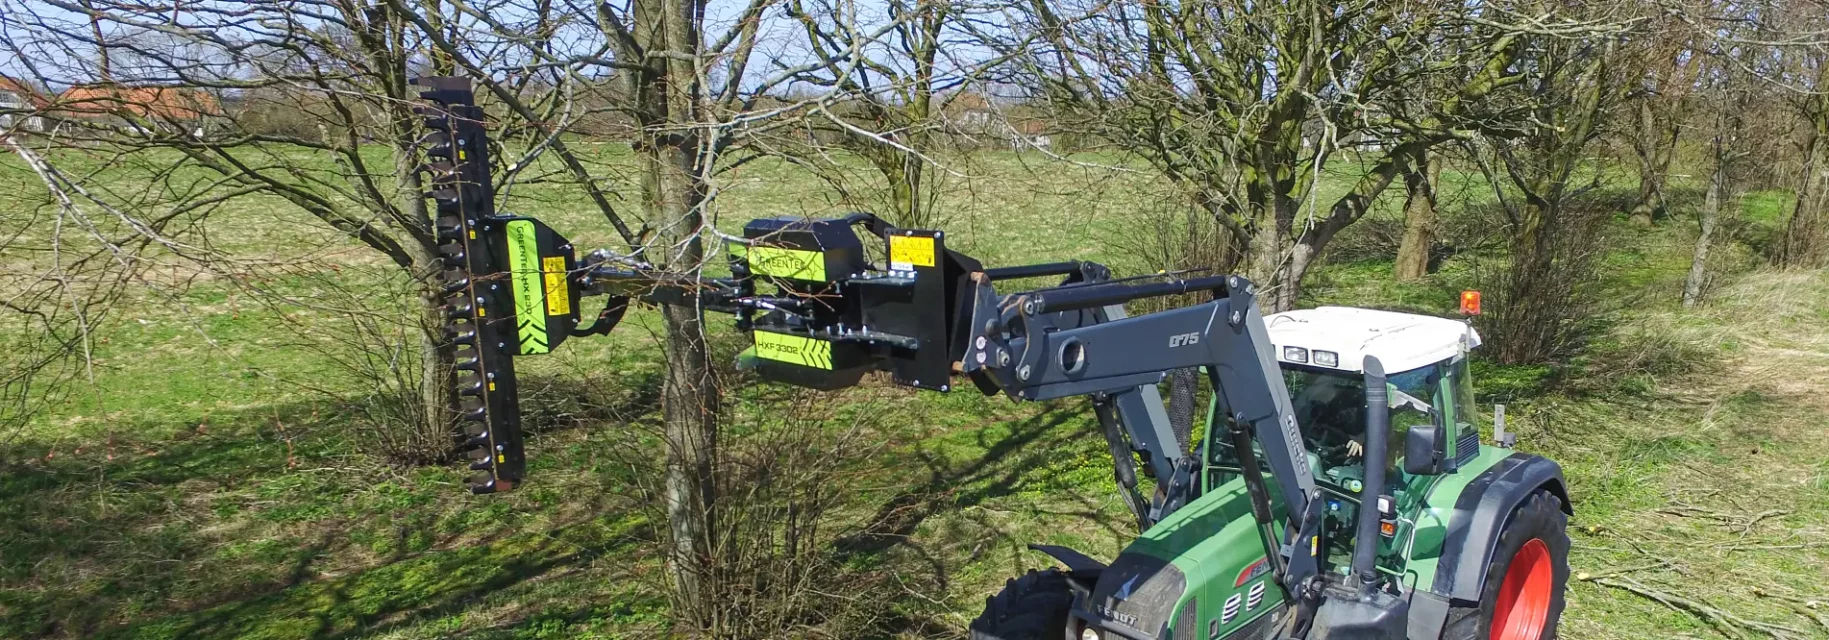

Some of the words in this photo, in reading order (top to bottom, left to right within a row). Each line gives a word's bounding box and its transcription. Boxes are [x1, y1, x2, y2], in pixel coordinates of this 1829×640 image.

[757, 341, 775, 350] HXF
[776, 344, 799, 355] 3302
[1250, 561, 1270, 576] FEN
[1097, 604, 1138, 626] FENDT
